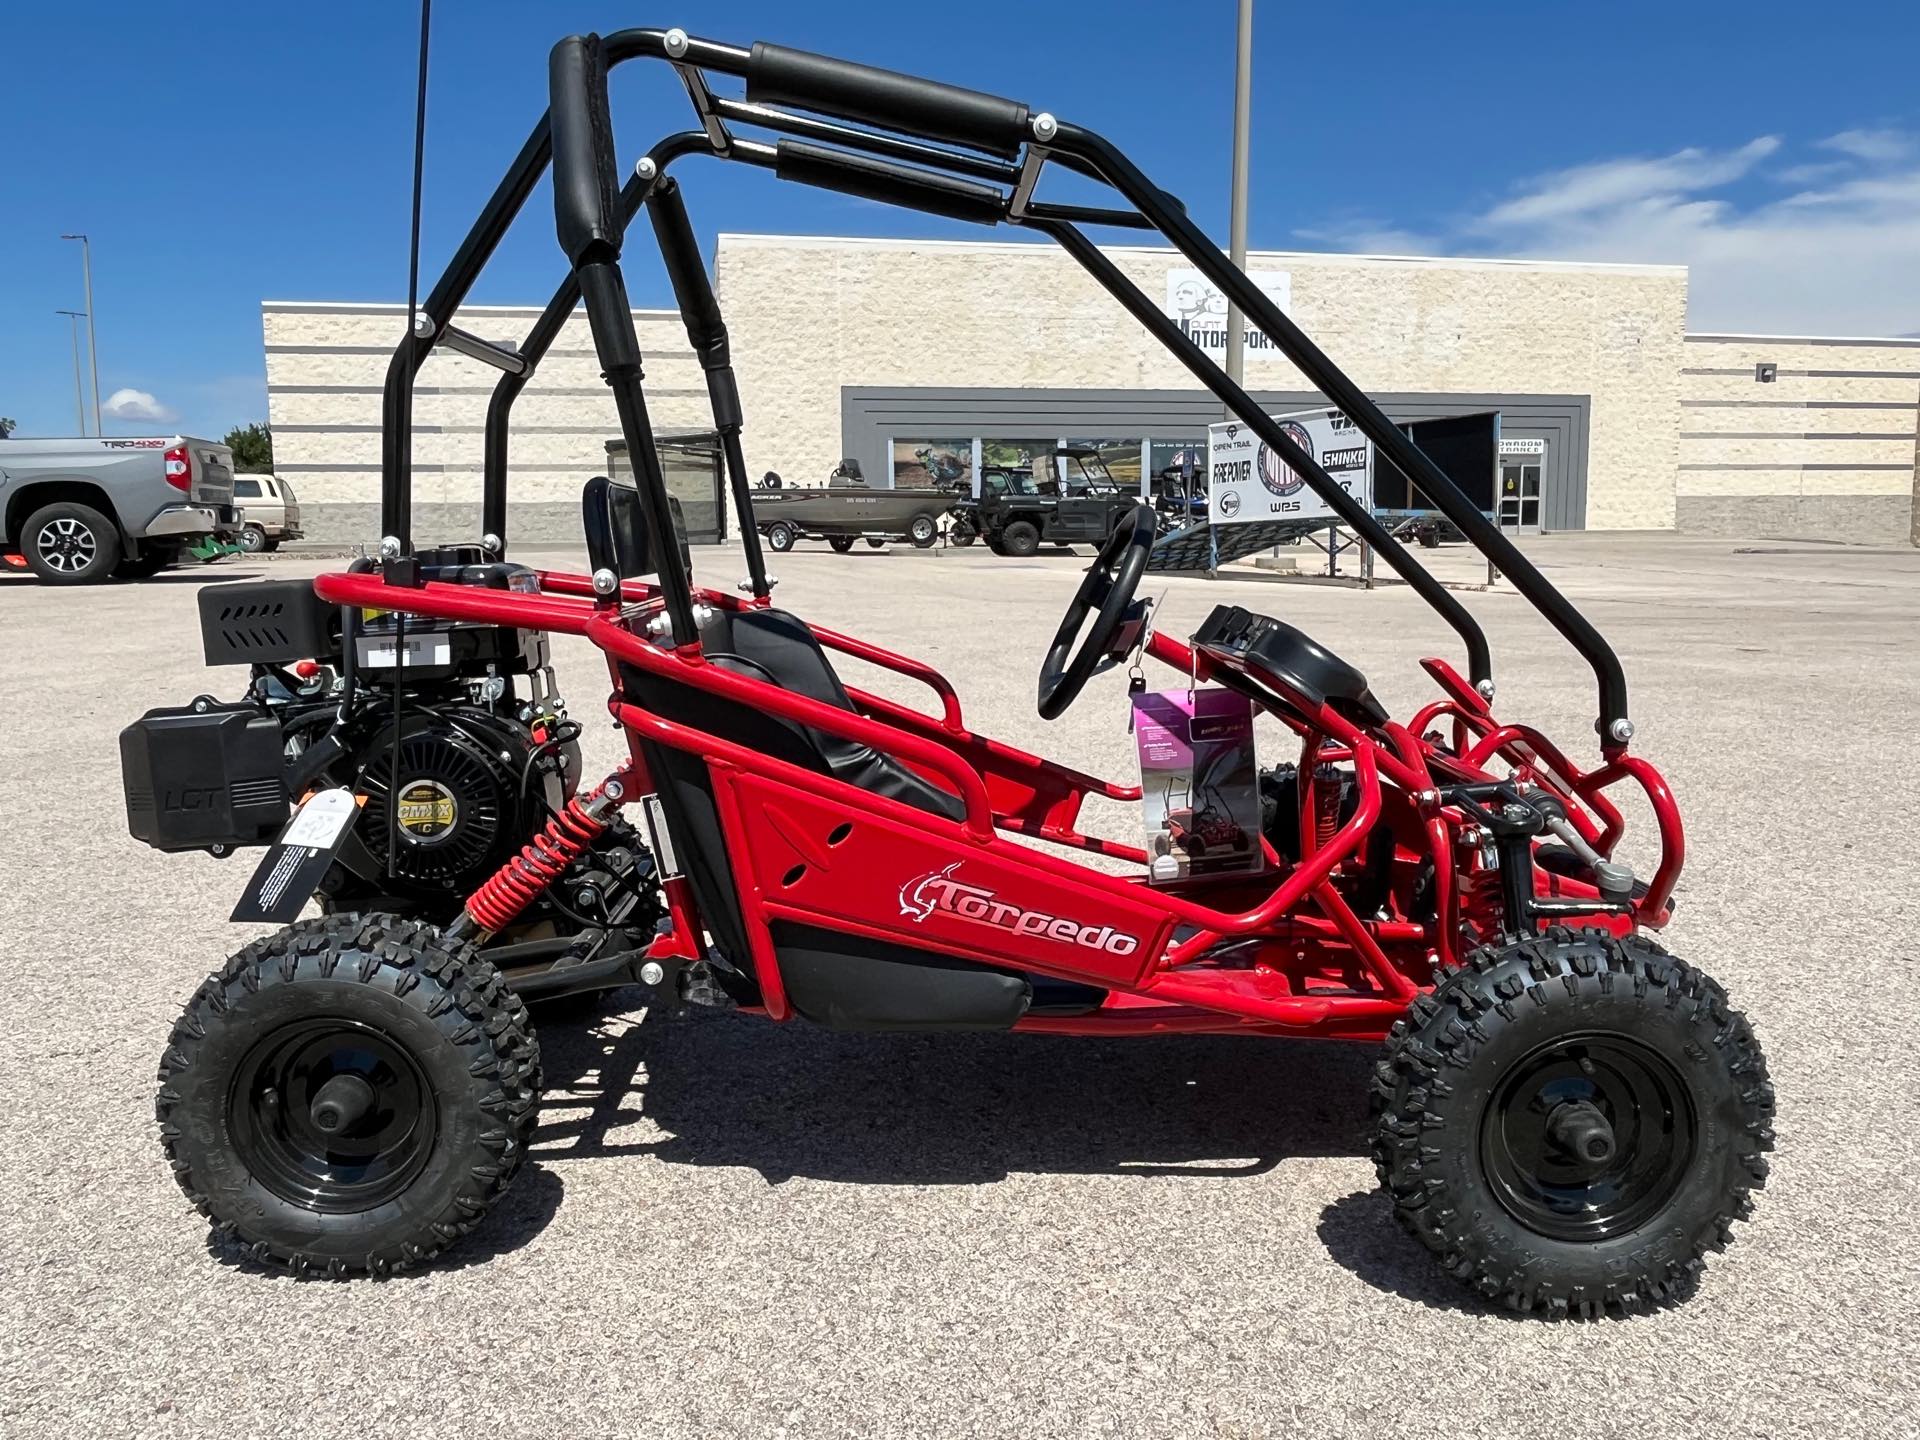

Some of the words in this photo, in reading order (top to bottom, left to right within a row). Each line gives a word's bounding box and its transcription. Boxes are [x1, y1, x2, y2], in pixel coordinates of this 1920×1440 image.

[101, 441, 134, 449] TRD
[1213, 442, 1232, 452] OPEN
[1233, 440, 1252, 449] TRAIL
[1323, 450, 1366, 467] SHINKO
[1213, 460, 1251, 485] FIREPOWER
[1270, 501, 1300, 513] WPS
[929, 879, 1138, 956] Torpedo
